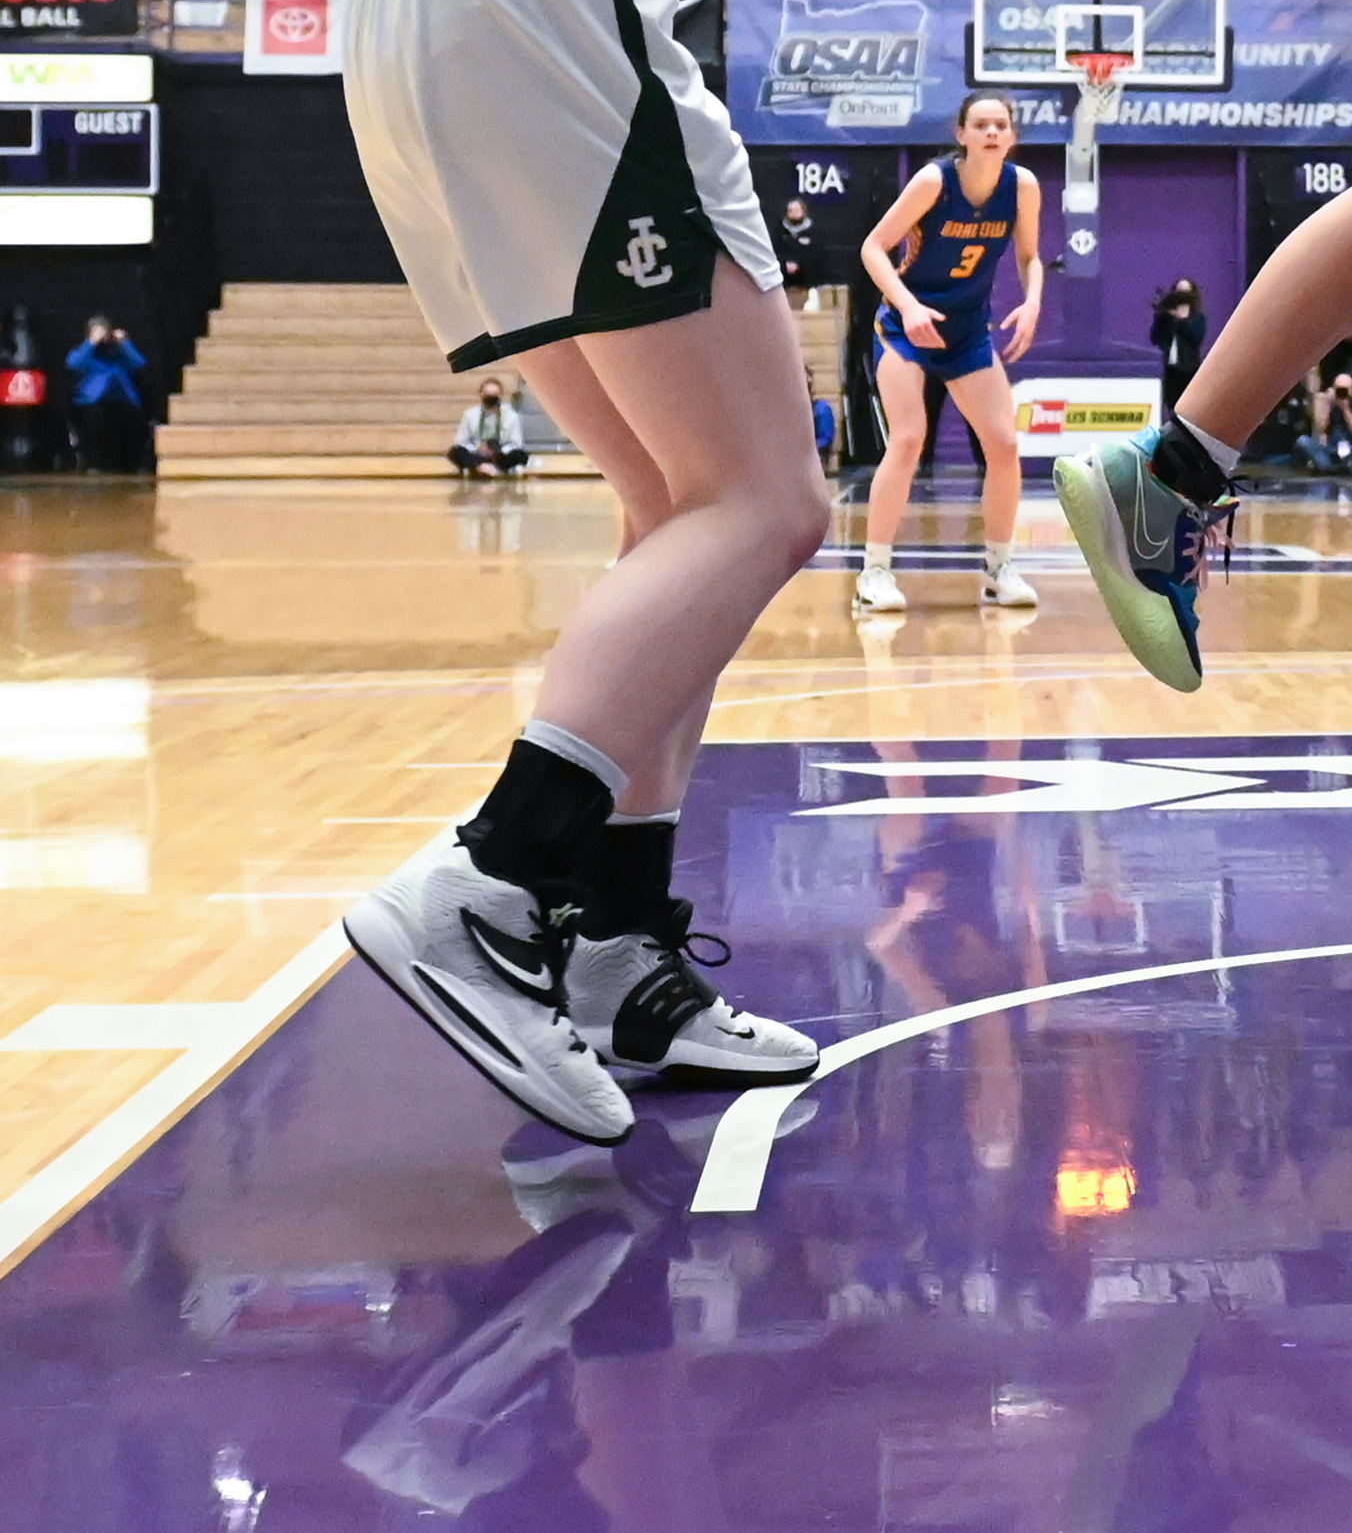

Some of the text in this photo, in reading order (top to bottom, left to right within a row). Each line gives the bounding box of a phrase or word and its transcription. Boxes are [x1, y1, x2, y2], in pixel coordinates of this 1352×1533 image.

[777, 38, 921, 76] OSAA
[74, 112, 143, 134] GUEST
[796, 163, 846, 194] 18A
[1303, 162, 1346, 194] 18B
[950, 244, 986, 278] 3
